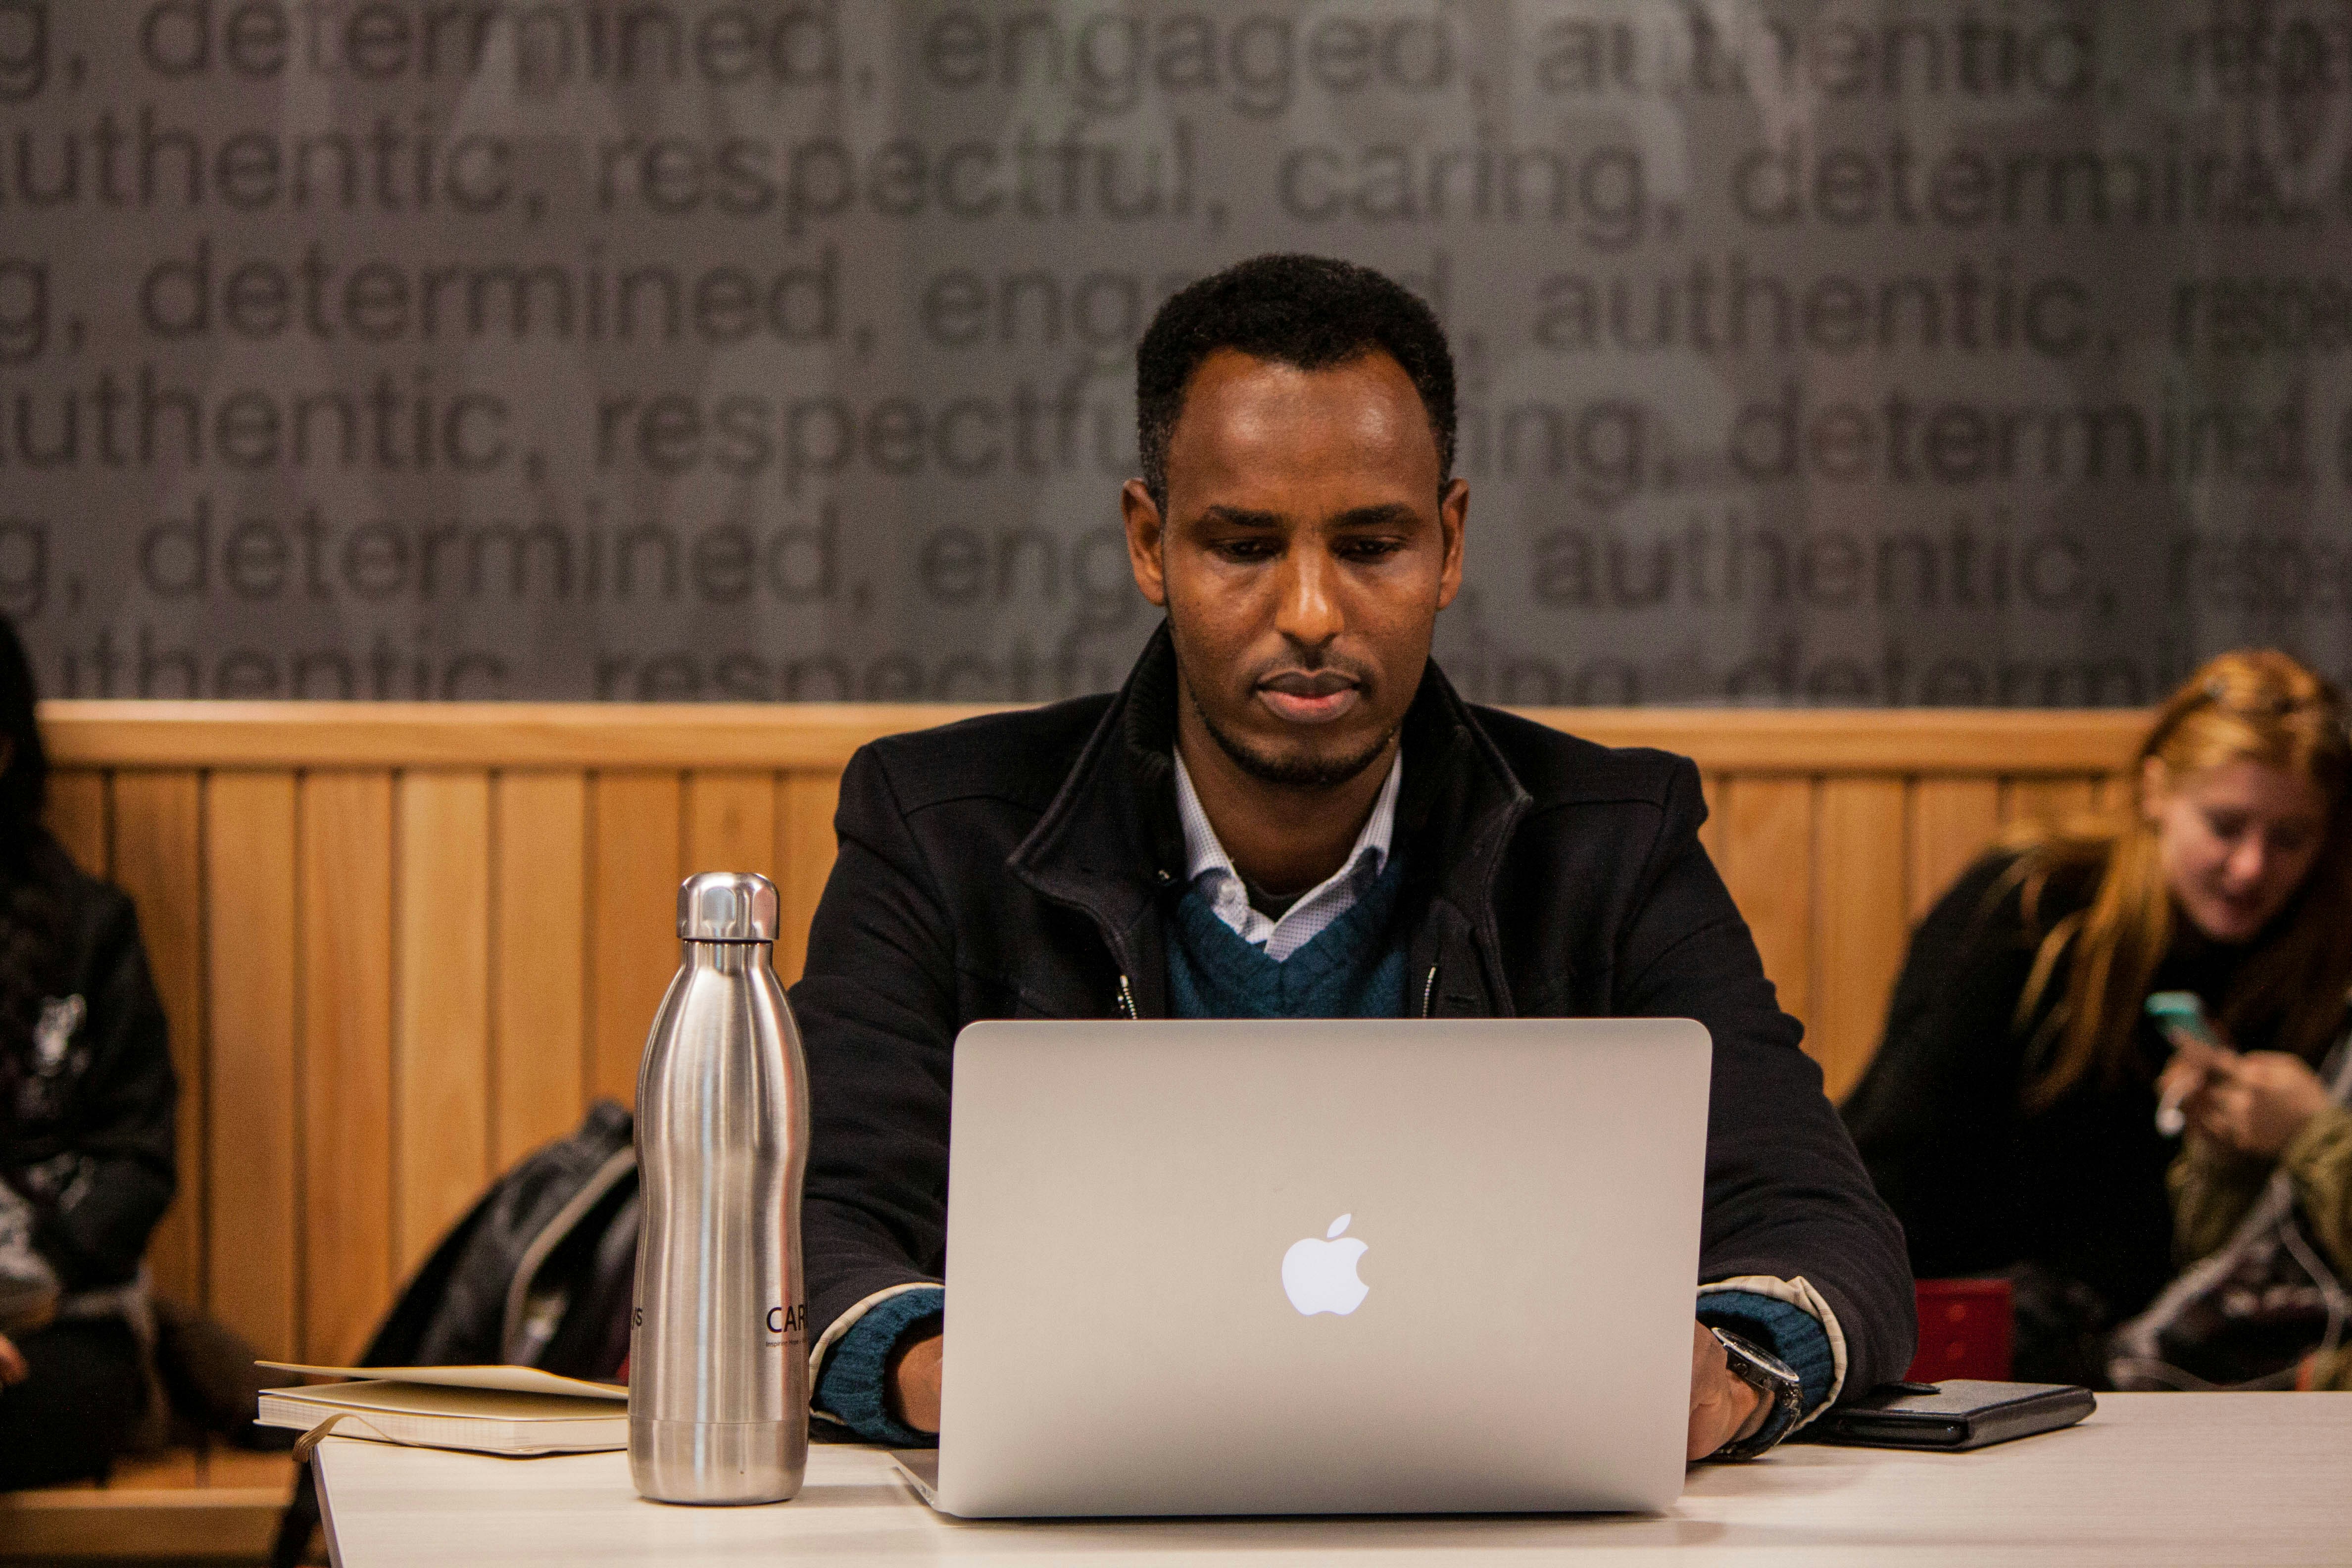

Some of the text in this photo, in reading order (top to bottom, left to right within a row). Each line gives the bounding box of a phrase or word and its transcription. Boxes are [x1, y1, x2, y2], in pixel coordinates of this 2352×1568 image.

[0, 106, 547, 230] uthentic,
[596, 116, 1231, 243] respectful,
[1276, 121, 1684, 251] caring,
[138, 234, 875, 356] determined,
[1530, 252, 2121, 364] authentic,
[0, 364, 547, 485] uthentic,
[138, 495, 875, 621] determined,
[1530, 507, 2117, 621] authentic,
